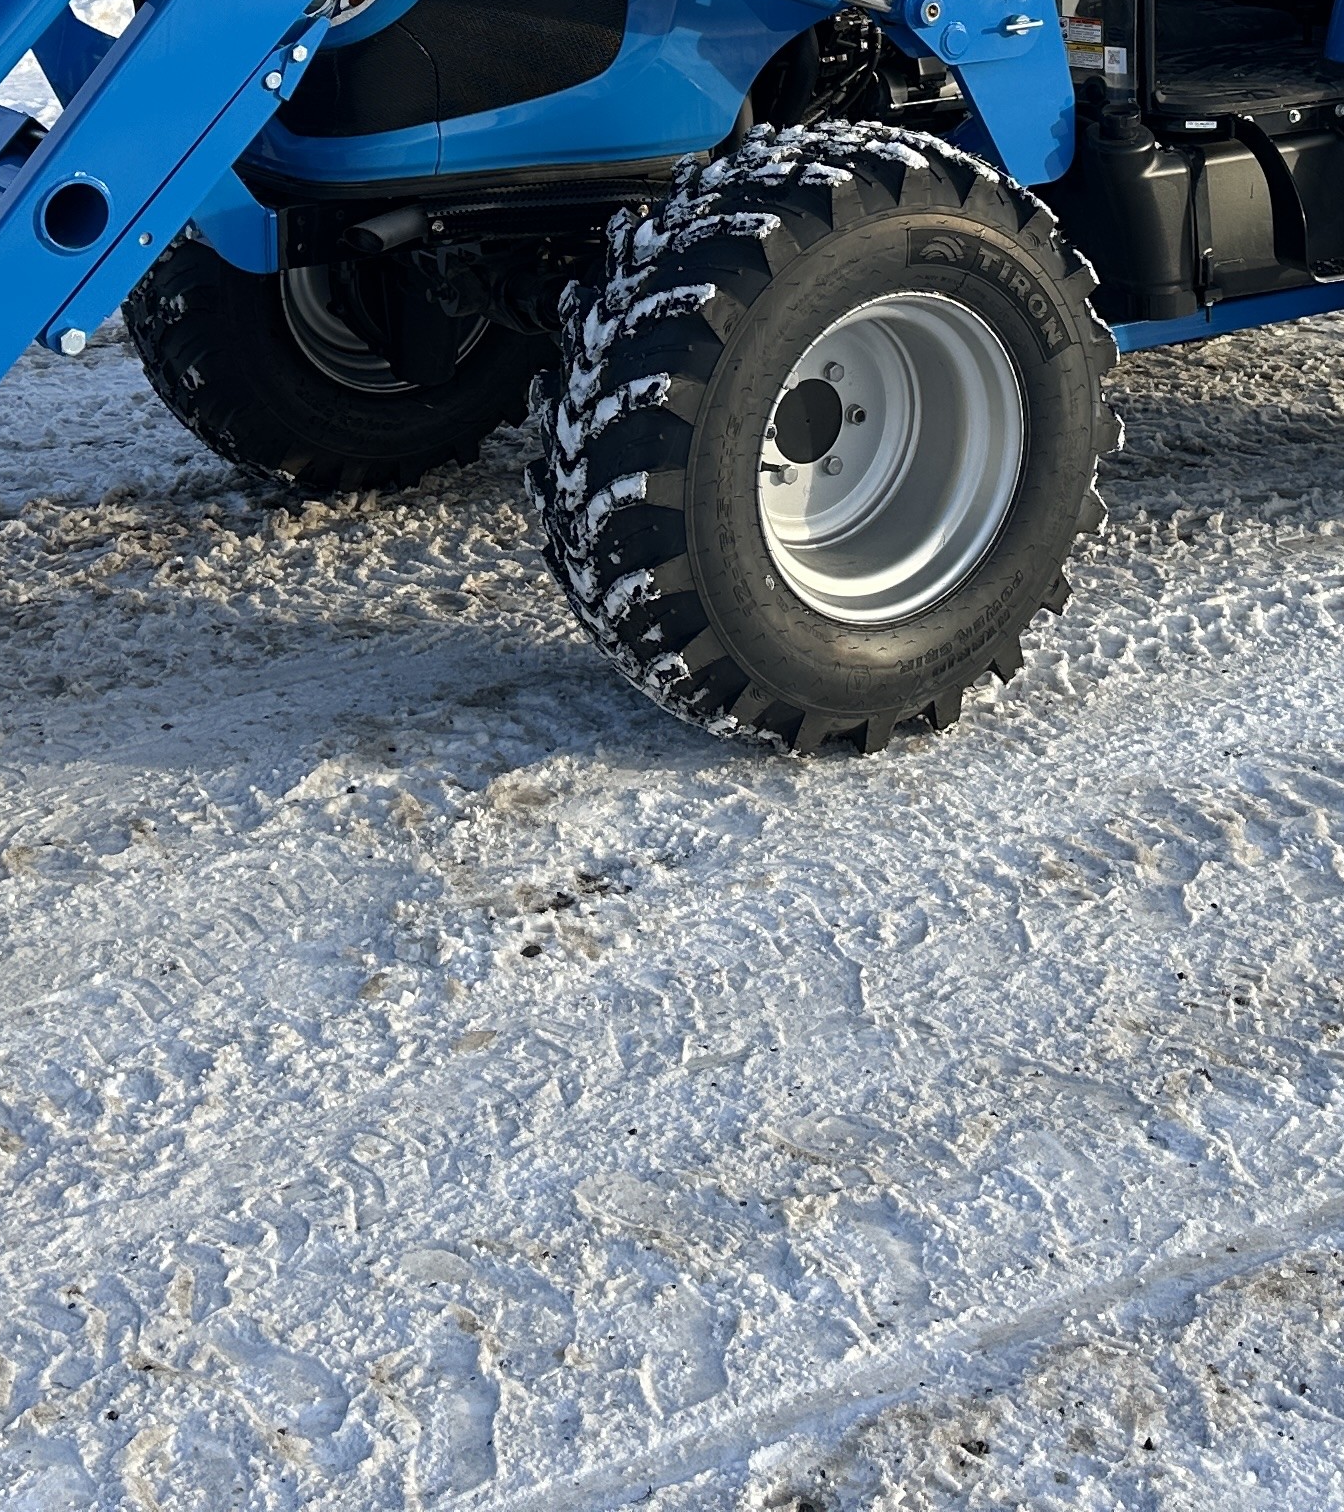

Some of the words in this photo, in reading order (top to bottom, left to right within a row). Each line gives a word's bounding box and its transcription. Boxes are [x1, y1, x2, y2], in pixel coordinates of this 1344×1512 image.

[977, 245, 1064, 350] TIRON
[957, 569, 1024, 645] POWER
[899, 641, 953, 674] GRIP
